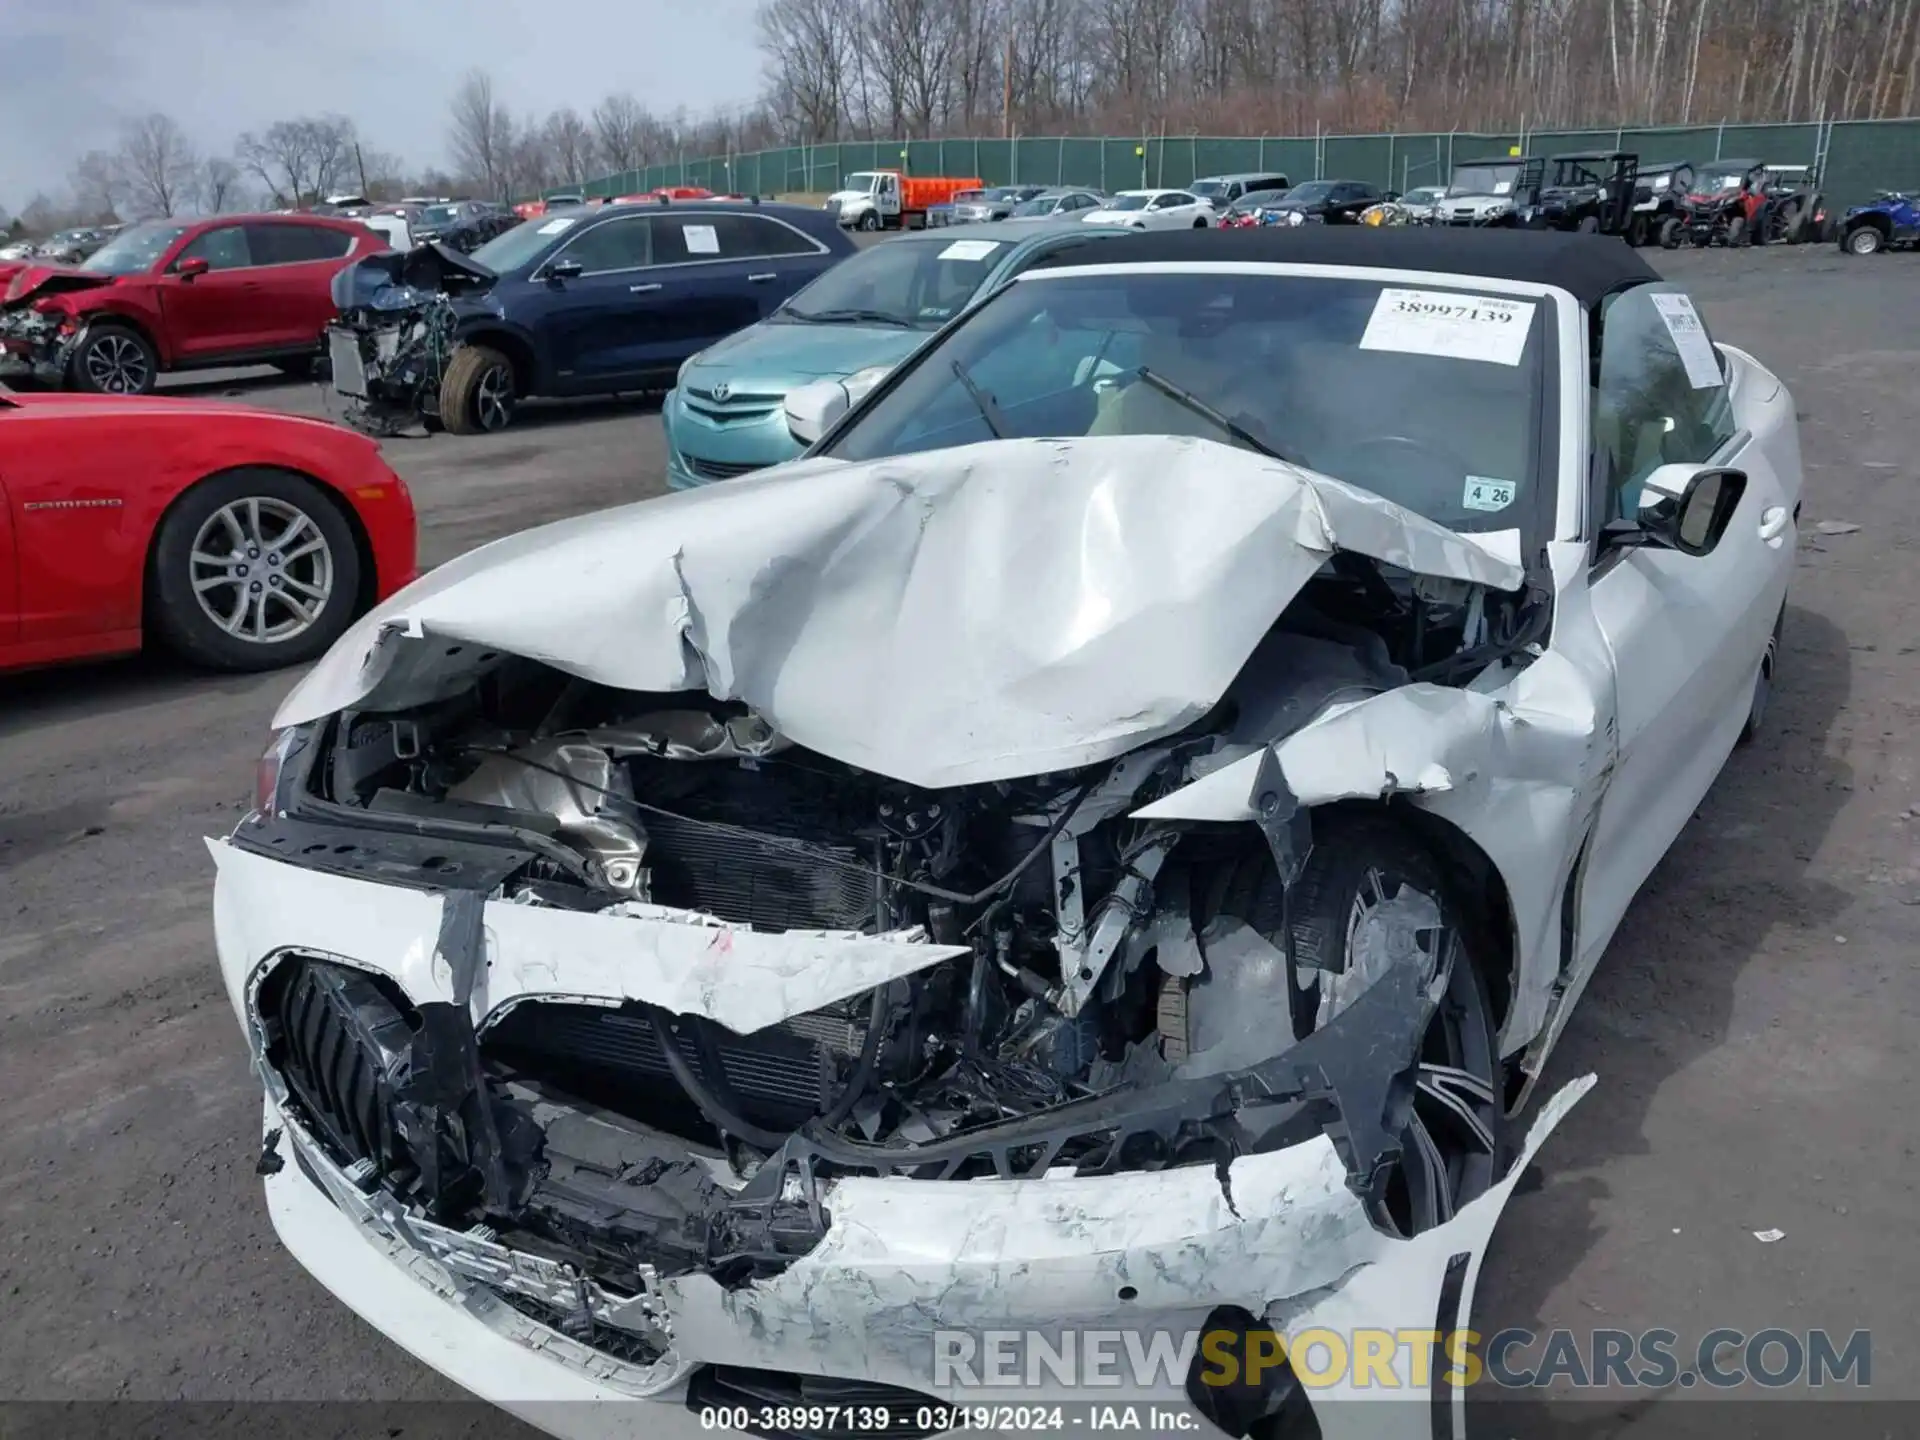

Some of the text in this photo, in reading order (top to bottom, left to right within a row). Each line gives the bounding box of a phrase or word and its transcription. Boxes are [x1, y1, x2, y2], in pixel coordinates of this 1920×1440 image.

[1391, 300, 1513, 324] 38997139
[1472, 486, 1510, 503] 4 26
